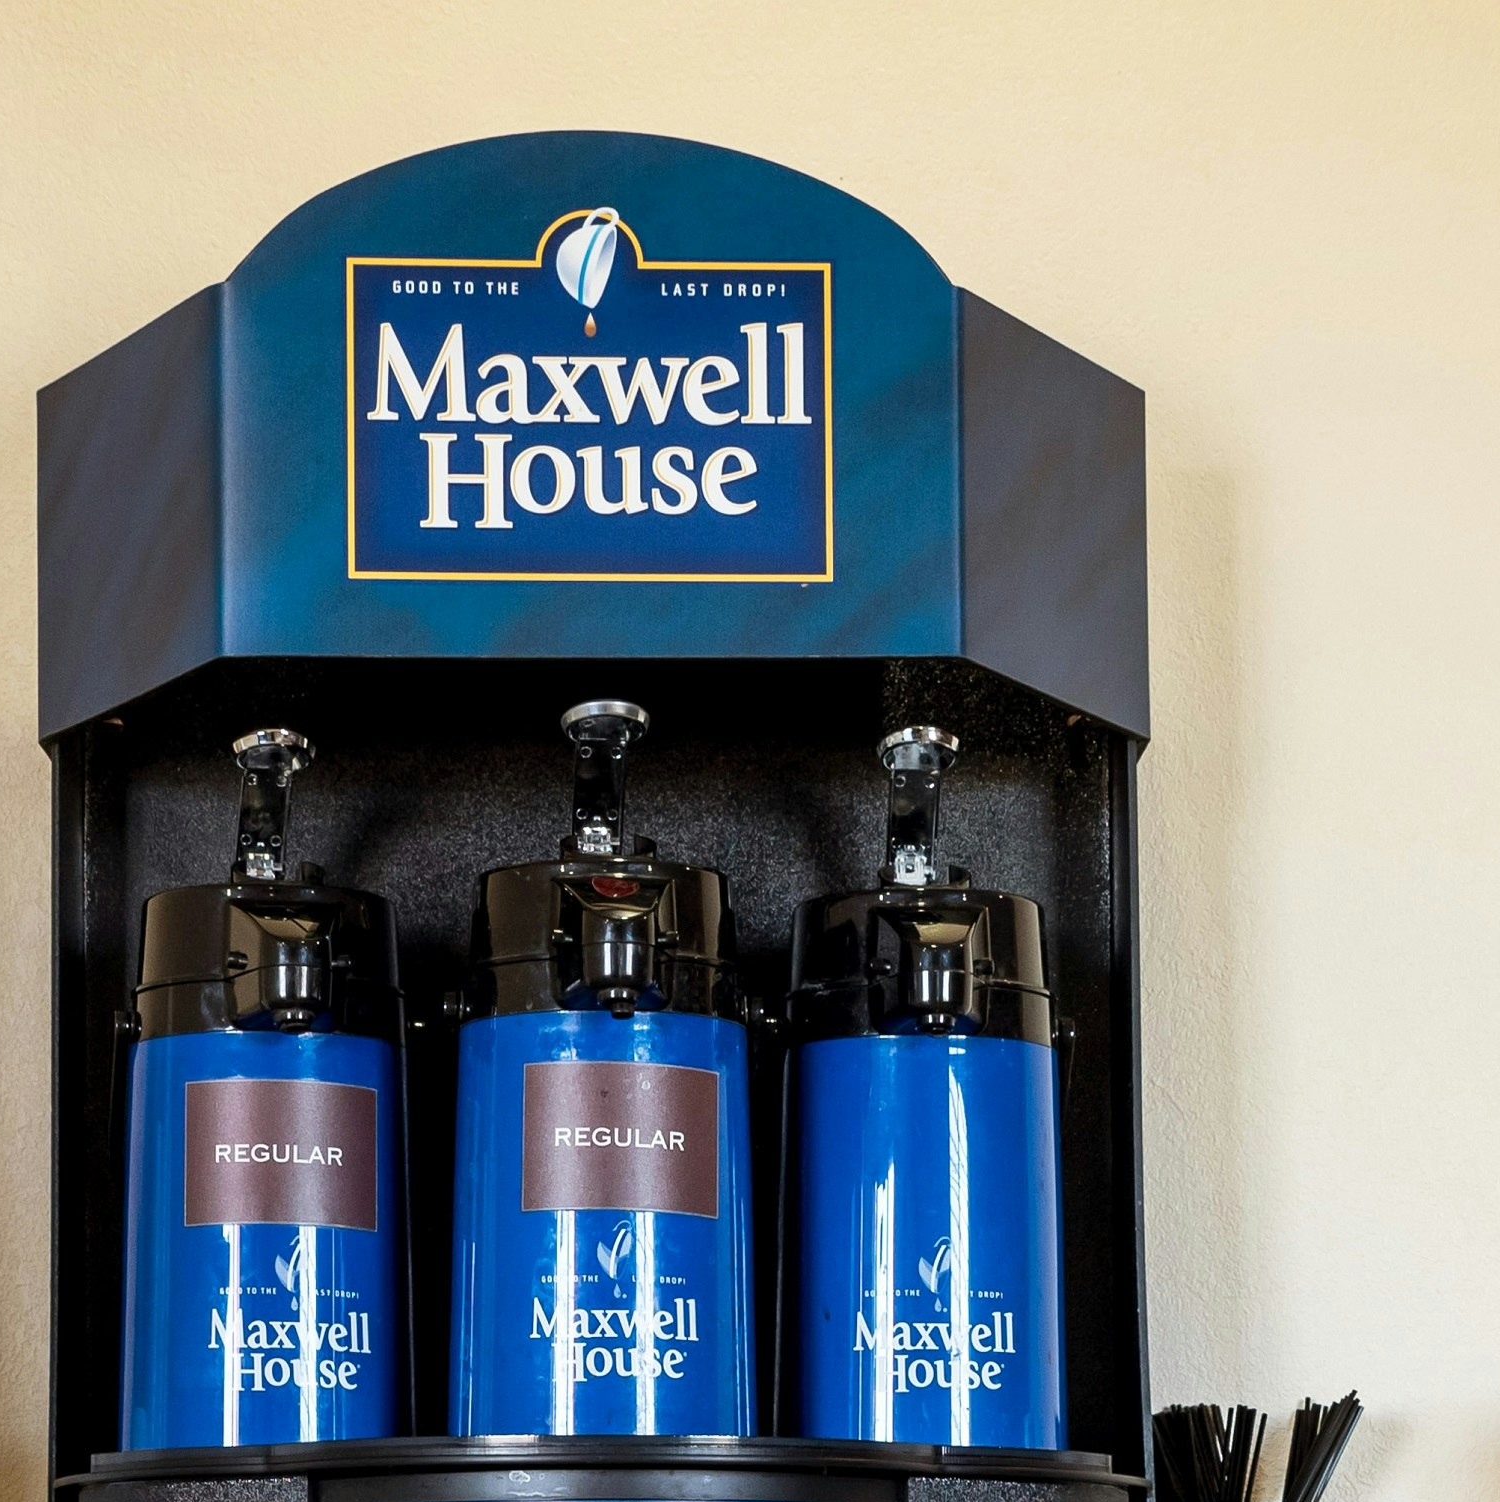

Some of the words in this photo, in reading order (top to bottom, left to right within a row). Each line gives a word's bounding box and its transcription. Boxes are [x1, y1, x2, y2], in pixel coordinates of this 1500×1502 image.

[392, 280, 442, 295] GOOD
[453, 281, 475, 295] TO
[486, 281, 520, 296] THE
[661, 282, 709, 297] LAST
[723, 283, 787, 298] DROP!
[367, 321, 812, 426] Maxwell
[418, 432, 758, 529] House
[553, 1126, 685, 1152] REGULAR
[215, 1142, 343, 1167] REGULAR
[583, 1274, 599, 1283] THE
[660, 1275, 686, 1285] DROP!
[246, 1286, 258, 1296] TO
[261, 1286, 277, 1296] THE
[335, 1289, 360, 1300] DROP!
[904, 1289, 921, 1297] THE
[978, 1290, 1004, 1300] DROP!
